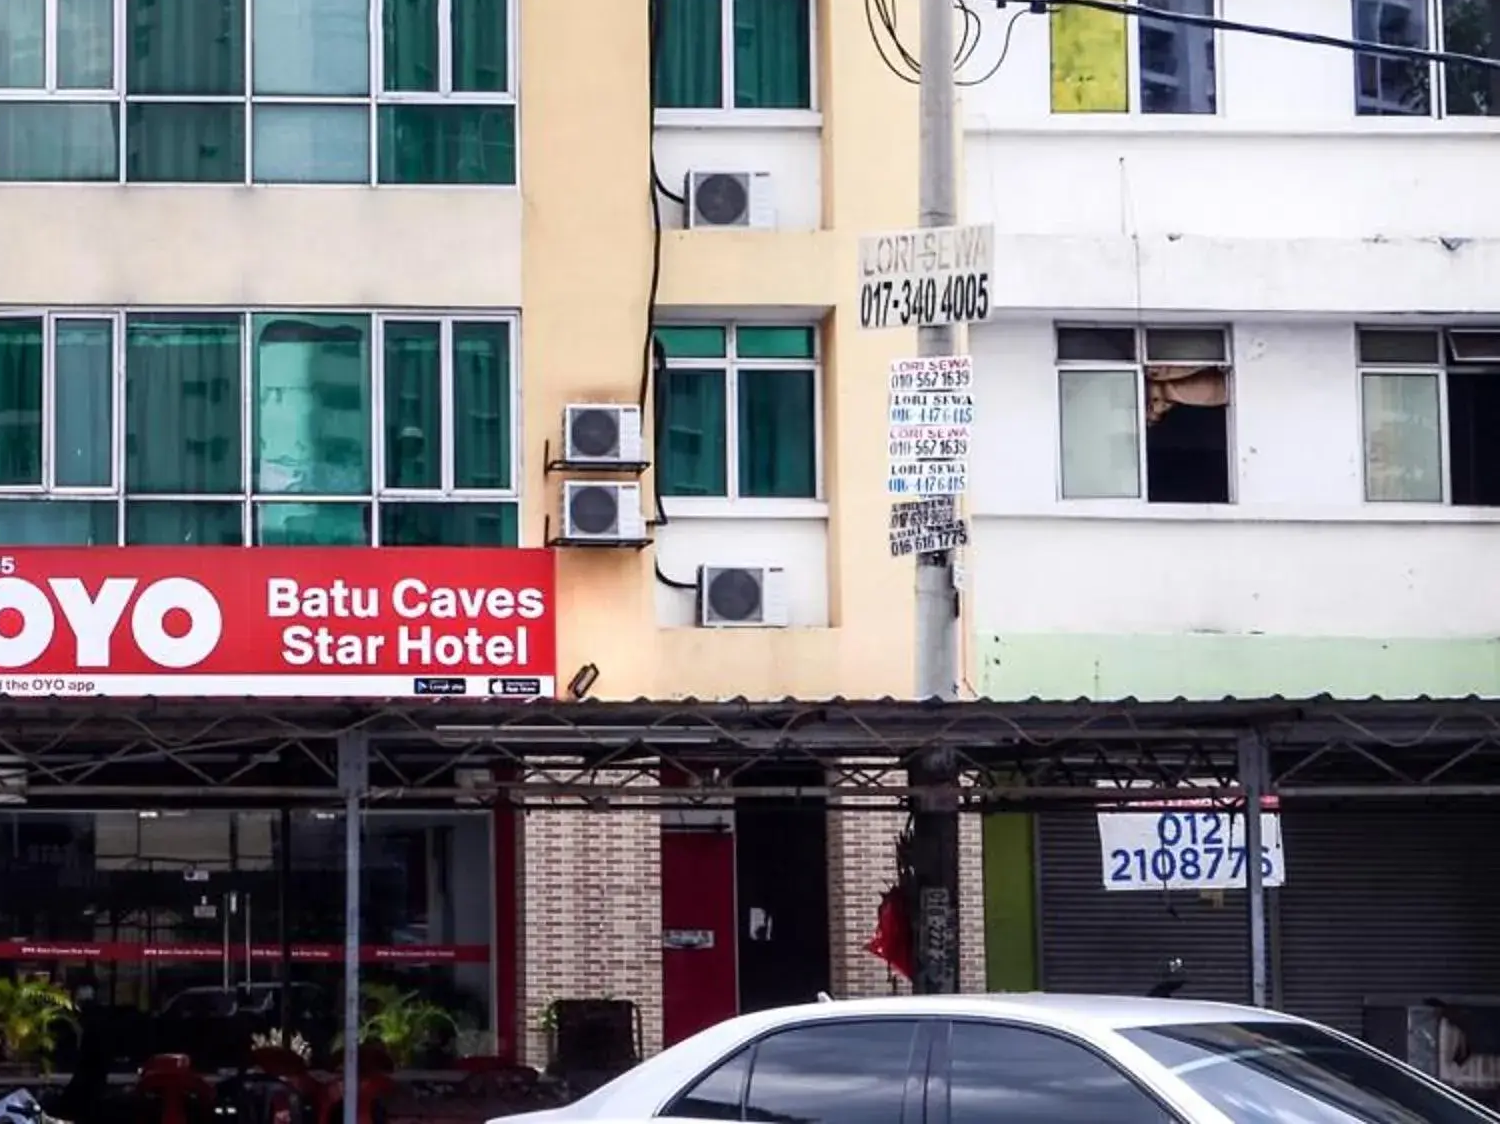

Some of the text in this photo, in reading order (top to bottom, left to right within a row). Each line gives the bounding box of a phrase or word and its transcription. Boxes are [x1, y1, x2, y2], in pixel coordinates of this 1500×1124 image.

[861, 272, 988, 327] 017-340 4005
[891, 358, 970, 372] LORI SEWA
[928, 427, 969, 439] SEWA
[938, 528, 967, 547] 1775
[268, 578, 545, 618] Batu Caves
[282, 626, 527, 665] Star Hotel
[7, 679, 95, 693] the OYO app
[1158, 811, 1223, 846] 012
